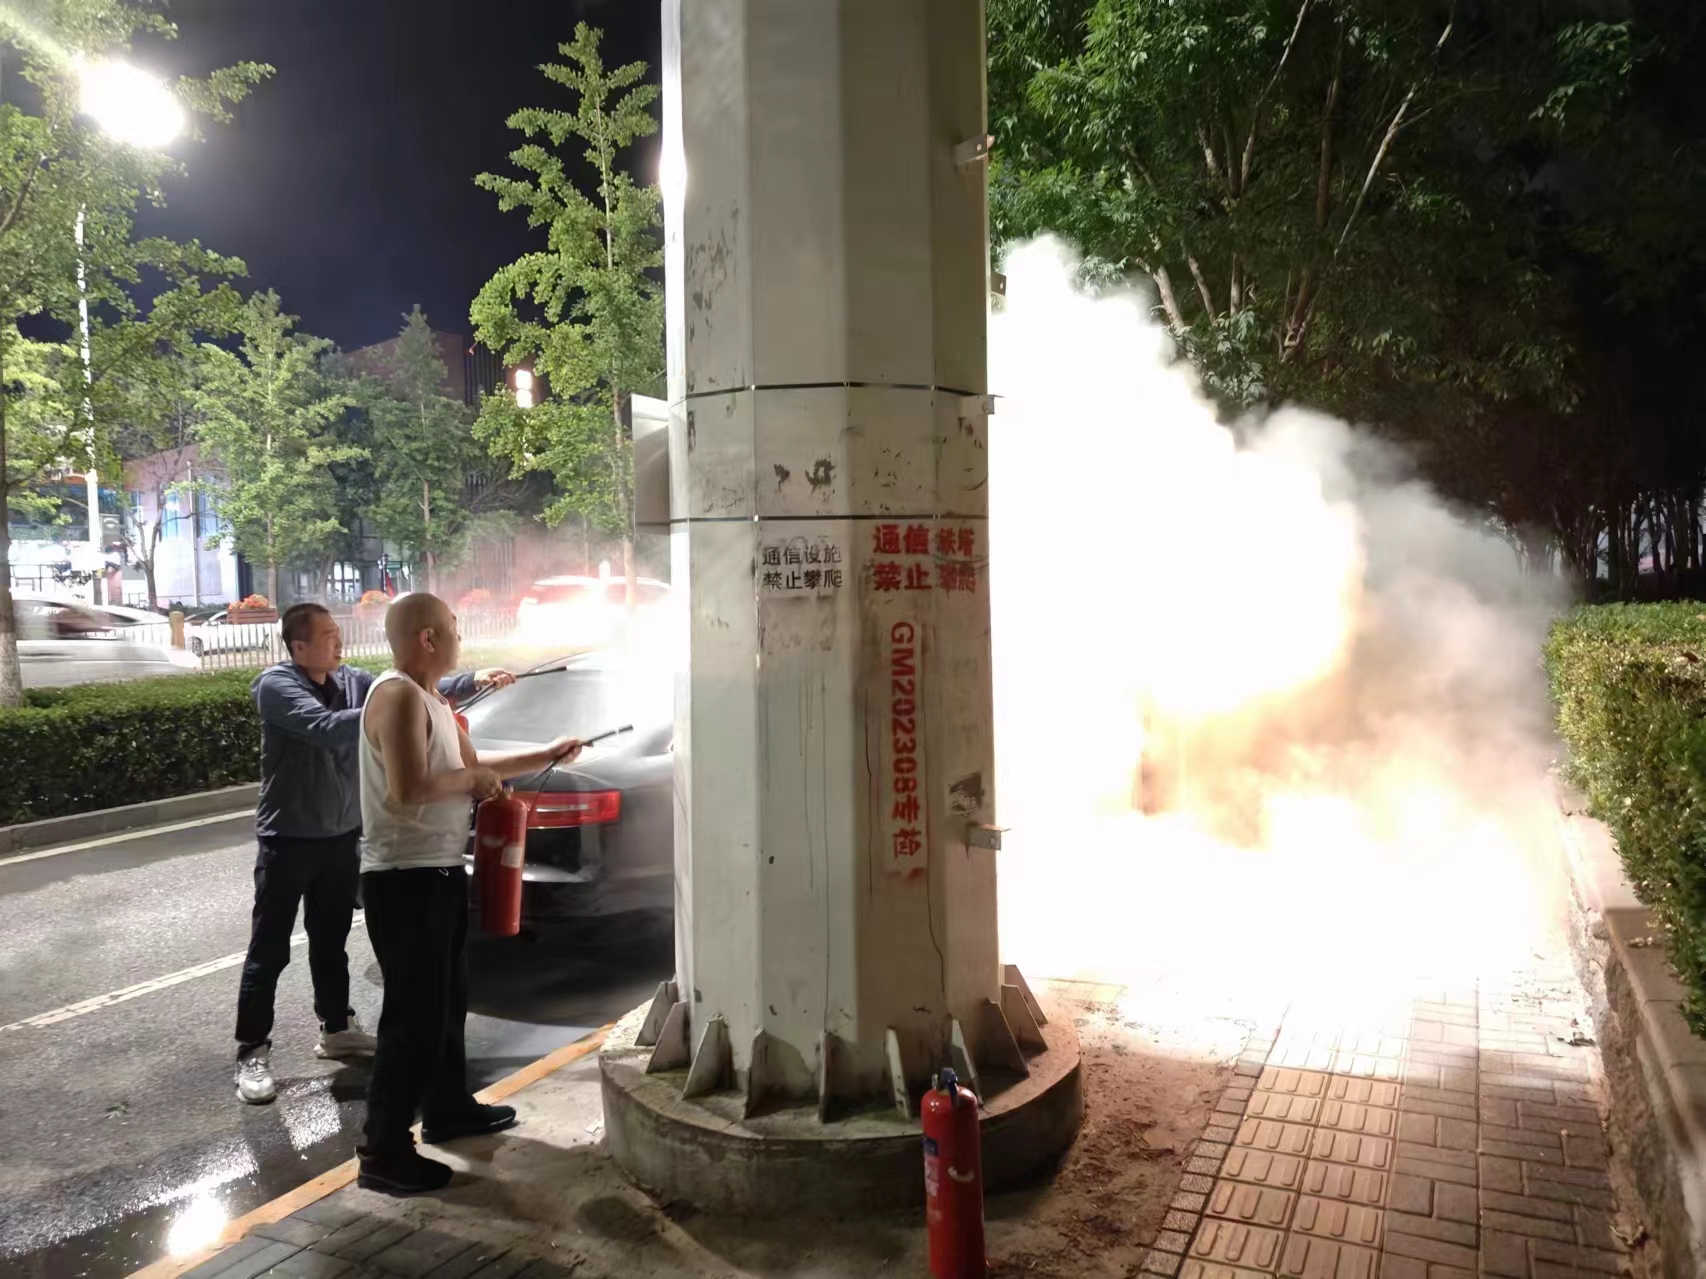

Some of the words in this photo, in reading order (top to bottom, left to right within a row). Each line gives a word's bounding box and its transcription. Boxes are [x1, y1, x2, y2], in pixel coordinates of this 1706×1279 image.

[762, 544, 842, 565] 通信设施
[762, 570, 842, 591] 禁止攀爬
[873, 562, 976, 593] 禁止攀爬
